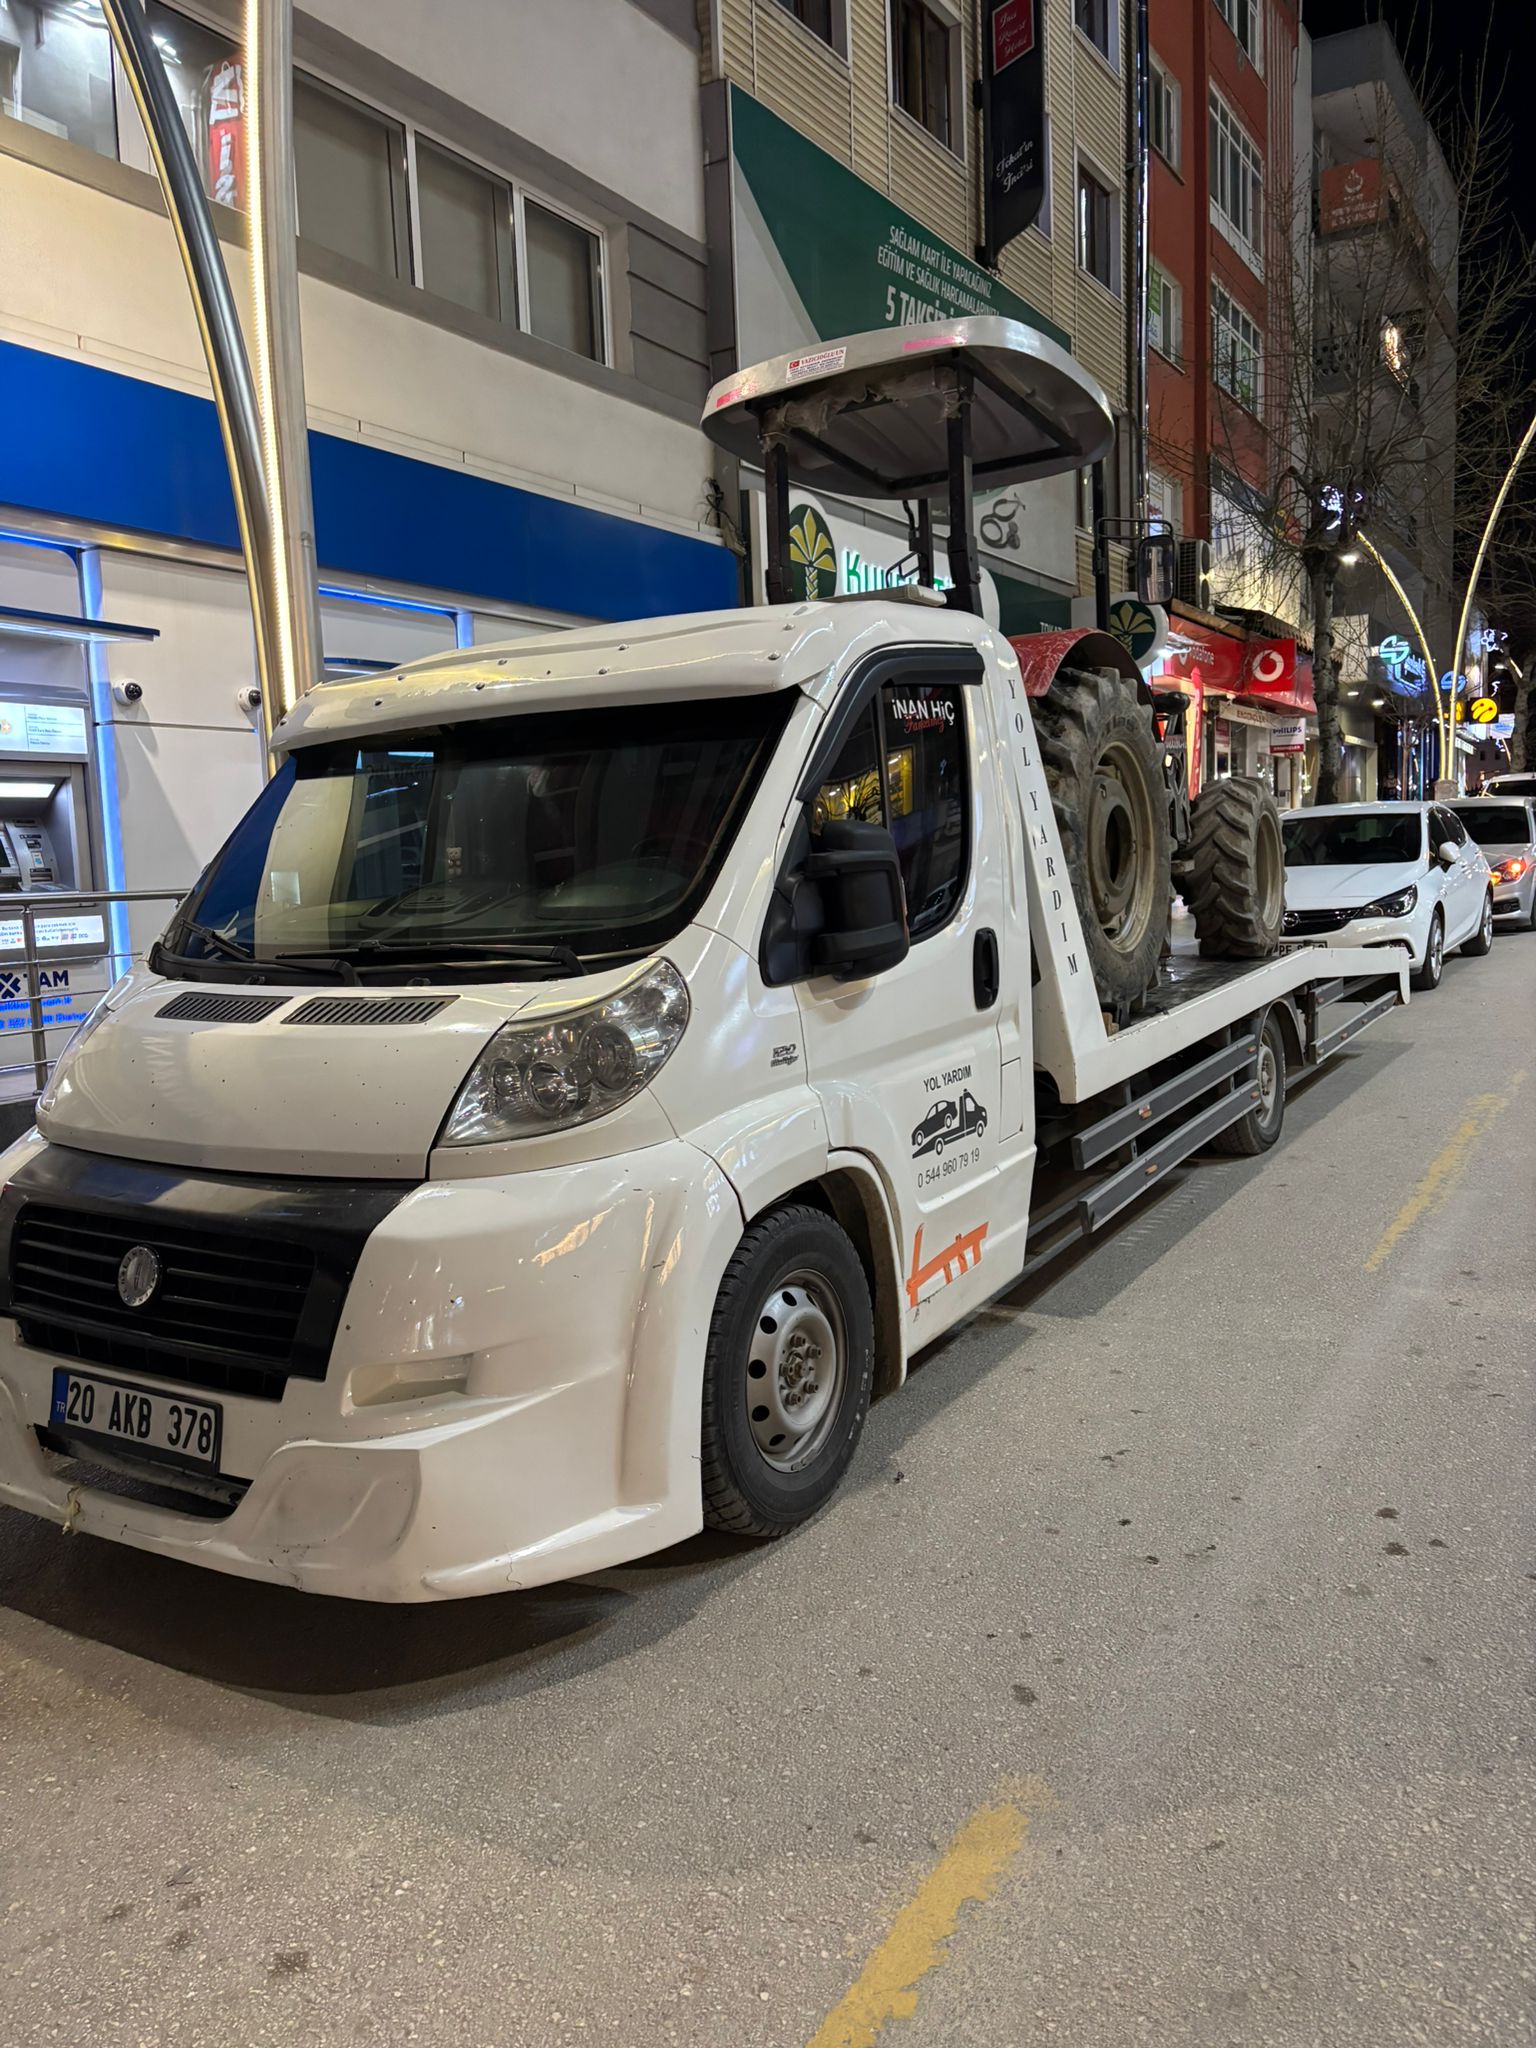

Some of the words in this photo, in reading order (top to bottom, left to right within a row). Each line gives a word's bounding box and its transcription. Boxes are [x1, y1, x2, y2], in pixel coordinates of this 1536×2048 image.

[877, 244, 905, 277] EĞİTİM
[905, 260, 917, 281] VE
[915, 267, 941, 295] SAĞLIK
[889, 225, 921, 259] SAĞLAM
[920, 243, 941, 269] KART
[940, 250, 952, 276] İLE
[952, 261, 993, 299] YAPACAĞINIZ
[885, 285, 897, 322] 5
[1272, 725, 1303, 735] PHILIPS
[1007, 679, 1031, 767] YOL
[1029, 790, 1079, 977] YARDIM
[923, 1076, 942, 1093] YOL
[941, 1064, 972, 1087] YARDIM
[917, 1172, 924, 1189] 0
[925, 1165, 941, 1185] 544
[942, 1157, 958, 1177] 960
[959, 1152, 969, 1169] 79
[970, 1146, 980, 1163] 19
[55, 1400, 66, 1414] TR
[66, 1380, 96, 1425] 20
[108, 1390, 152, 1439] AKB
[167, 1404, 213, 1455] 378
